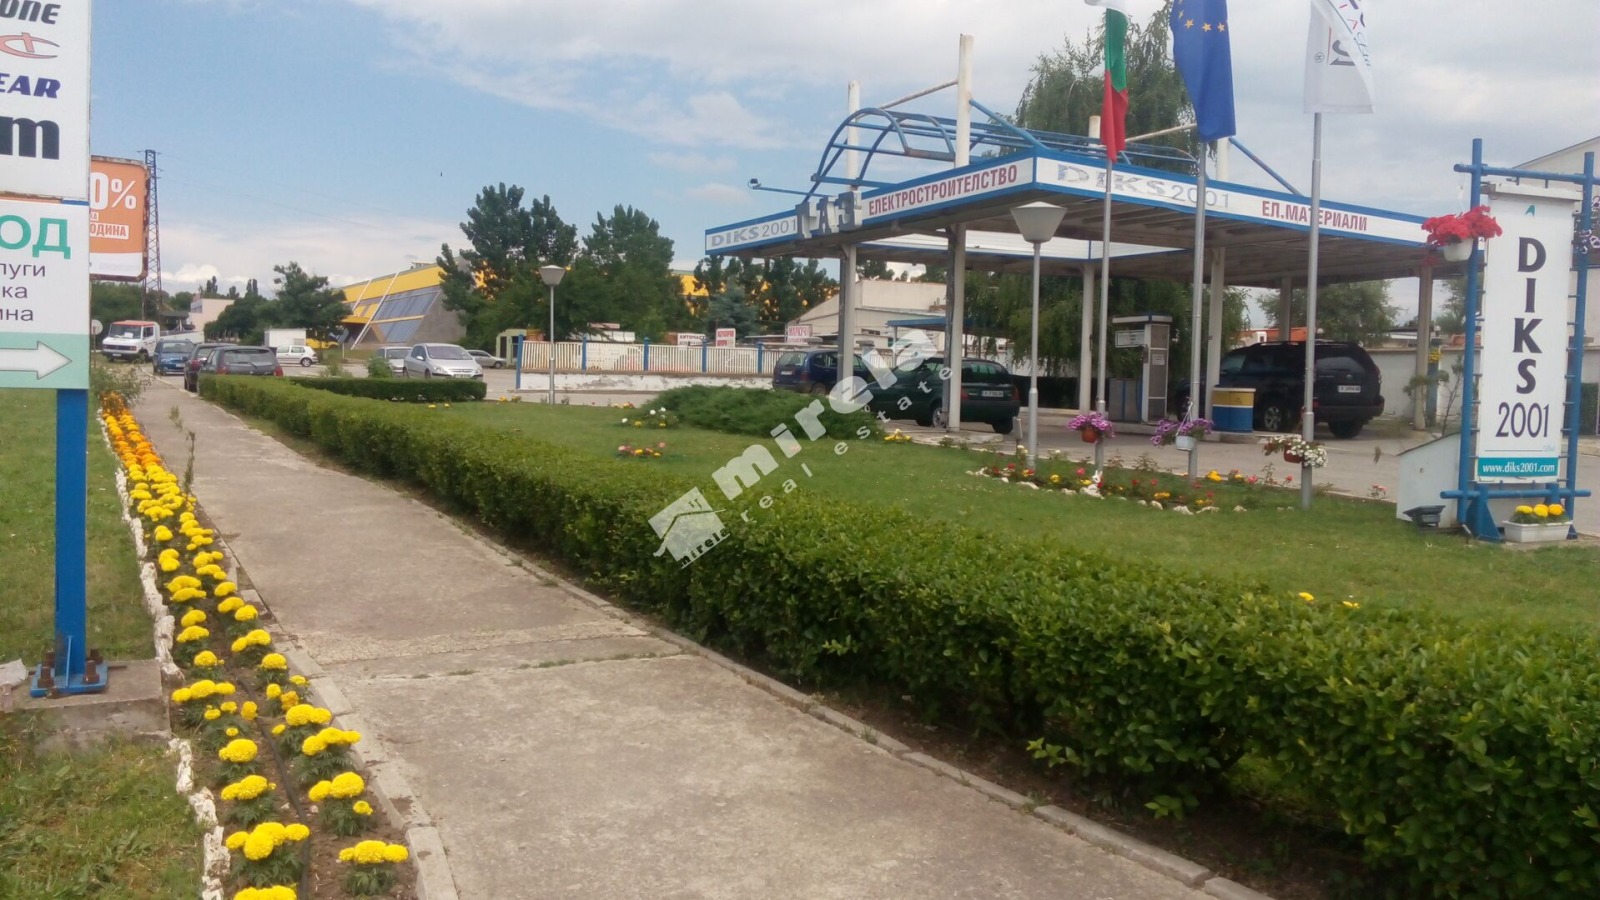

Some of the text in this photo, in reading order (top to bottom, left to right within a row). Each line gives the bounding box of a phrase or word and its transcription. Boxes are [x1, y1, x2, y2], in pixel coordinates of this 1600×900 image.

[0, 73, 61, 98] EAR
[868, 165, 1017, 216] ЕЛЕКТРОСТРОИТЕЛСТВО
[1262, 200, 1368, 232] ЕЛ.МАЕРИАЛИ
[711, 218, 797, 247] DIKS 2001
[0, 308, 34, 321] на
[1513, 236, 1547, 395] DIKS
[1495, 401, 1550, 438] 2001
[1482, 461, 1555, 473] www.diks2001.com
